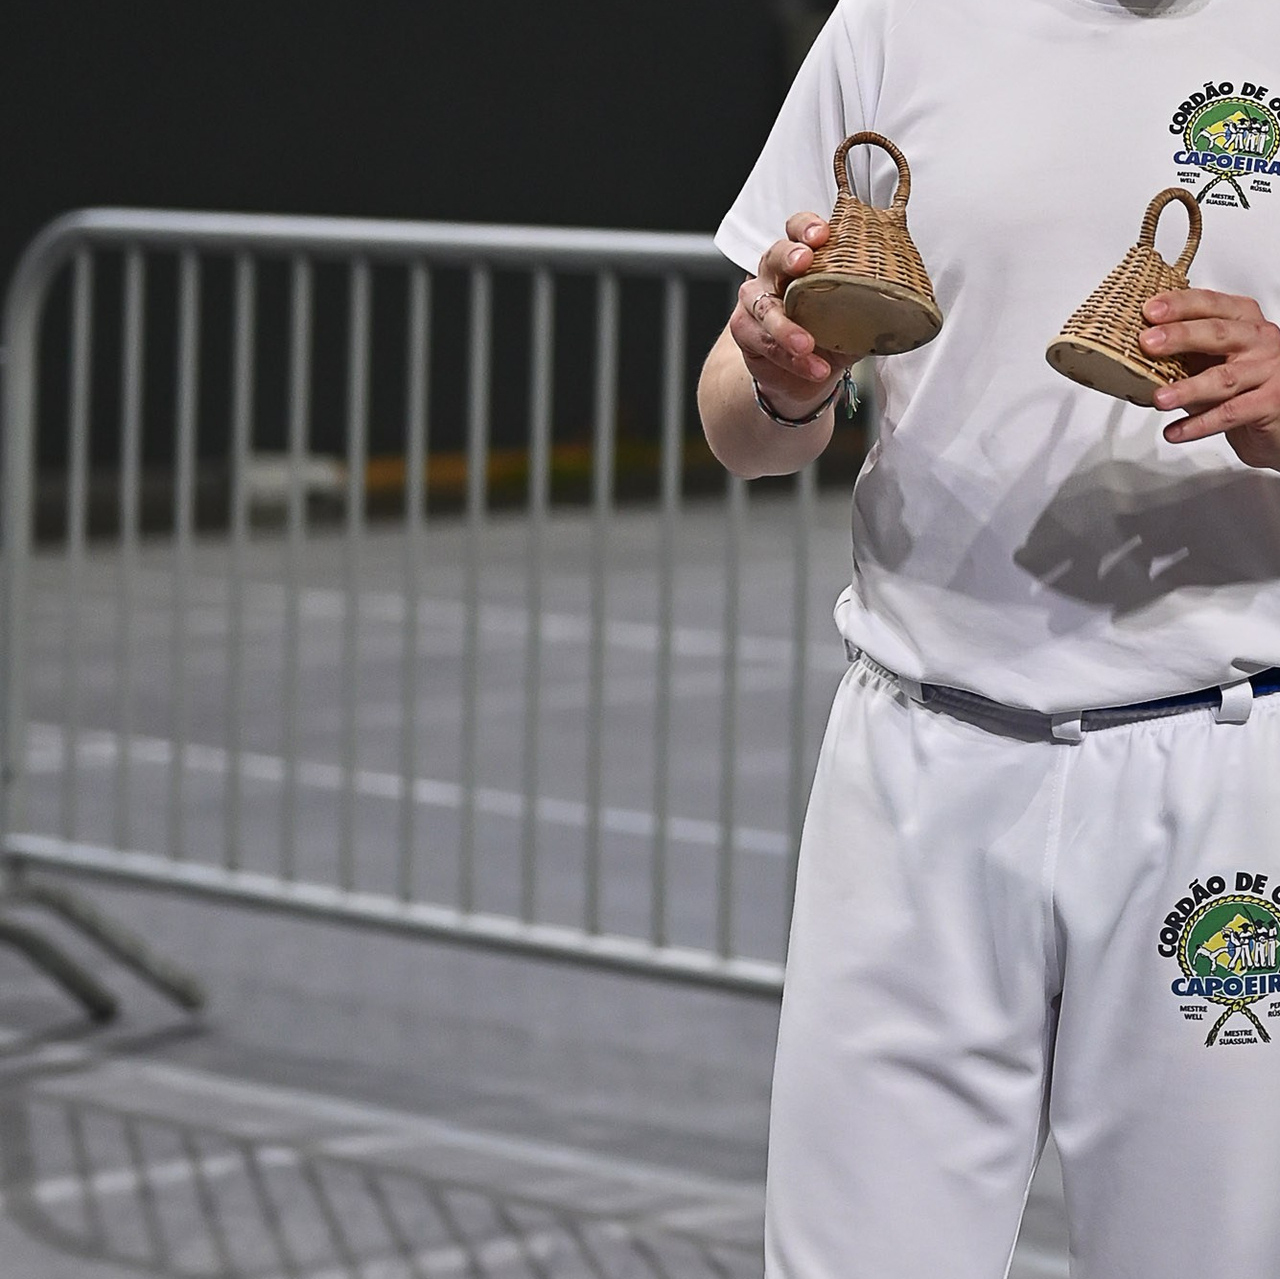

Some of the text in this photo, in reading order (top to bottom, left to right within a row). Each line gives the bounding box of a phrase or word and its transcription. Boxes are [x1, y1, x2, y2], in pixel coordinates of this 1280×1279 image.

[1169, 81, 1234, 135] CORDÃO
[1241, 82, 1269, 101] DE
[1253, 179, 1271, 187] PERM
[1211, 193, 1235, 201] MESTRE
[1206, 199, 1238, 208] SUASSUNA
[1158, 876, 1226, 958] CORDÃO
[1235, 872, 1268, 894] DE
[1180, 1005, 1208, 1013] MESTRE
[1184, 1013, 1203, 1021] WELL
[1224, 1029, 1253, 1037] MESTRE
[1219, 1037, 1257, 1045] SUASSUNA
